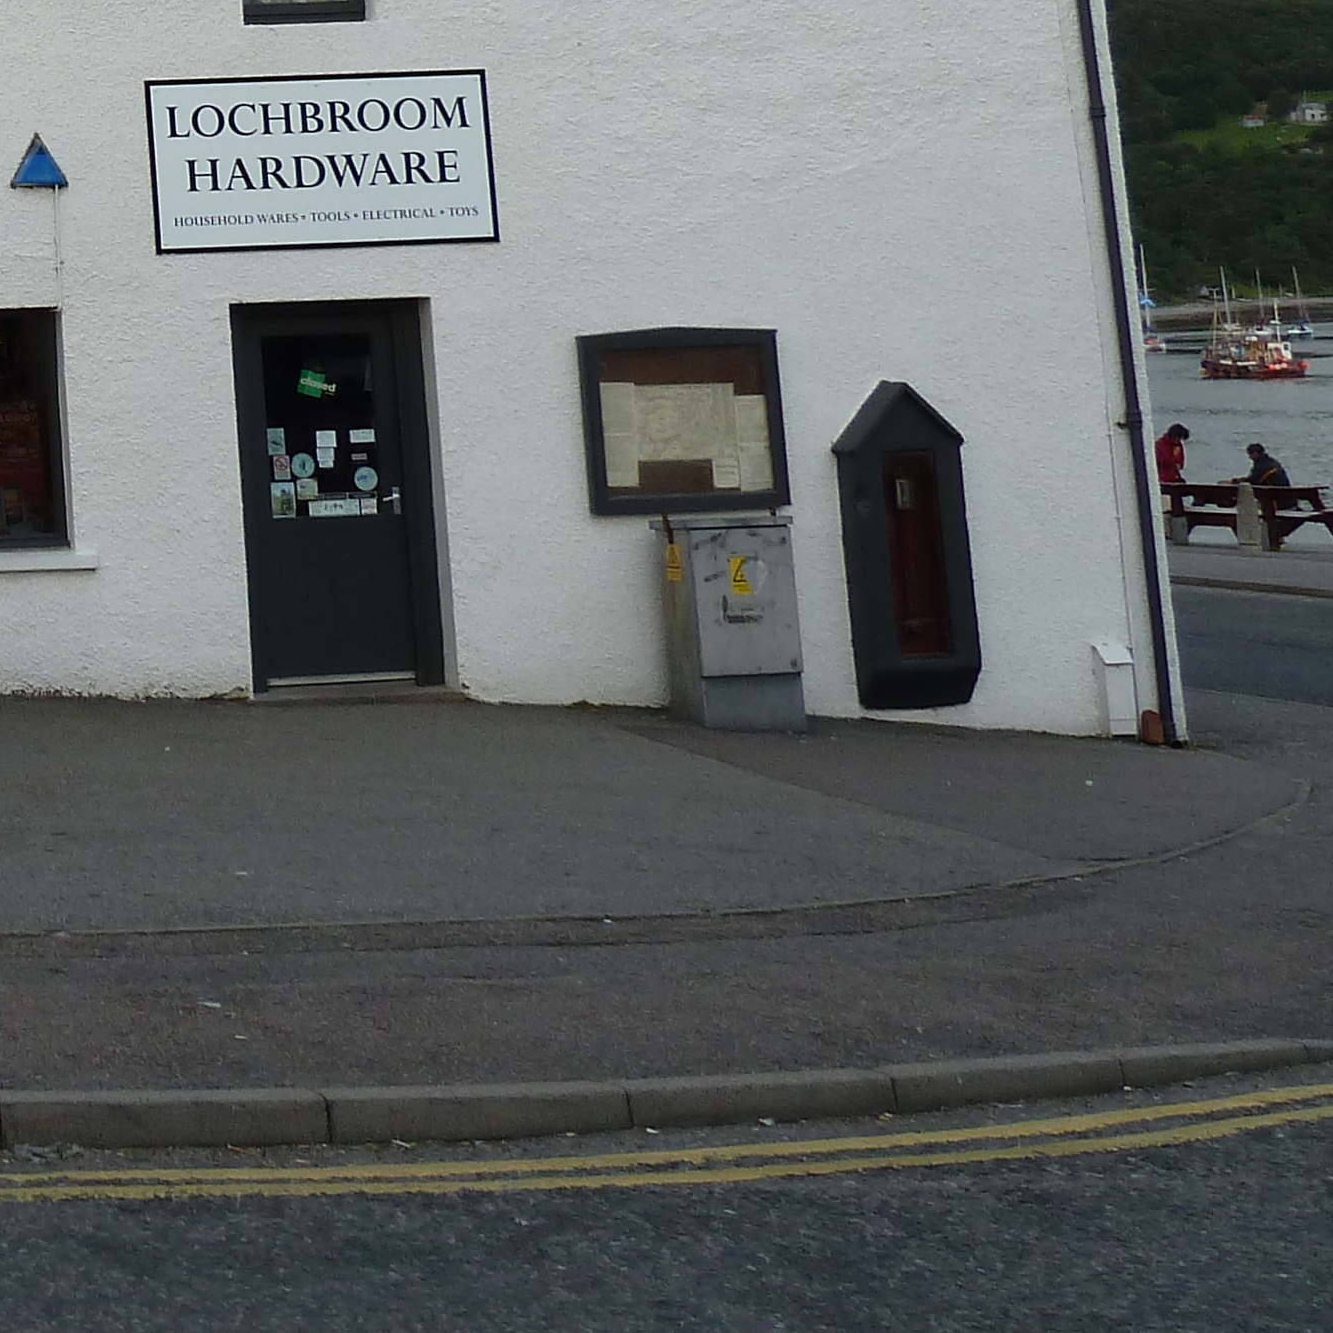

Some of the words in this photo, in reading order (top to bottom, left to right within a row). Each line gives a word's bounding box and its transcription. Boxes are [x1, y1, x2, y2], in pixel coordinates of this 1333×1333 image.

[165, 96, 471, 138] LOCHBROOM
[185, 150, 461, 192] HARDWARE
[174, 214, 255, 228] HOUSEHOLD
[257, 212, 300, 225] WARES
[310, 211, 351, 223] TOOLS
[362, 207, 437, 221] ELECTRICAL
[447, 205, 480, 217] TOYS
